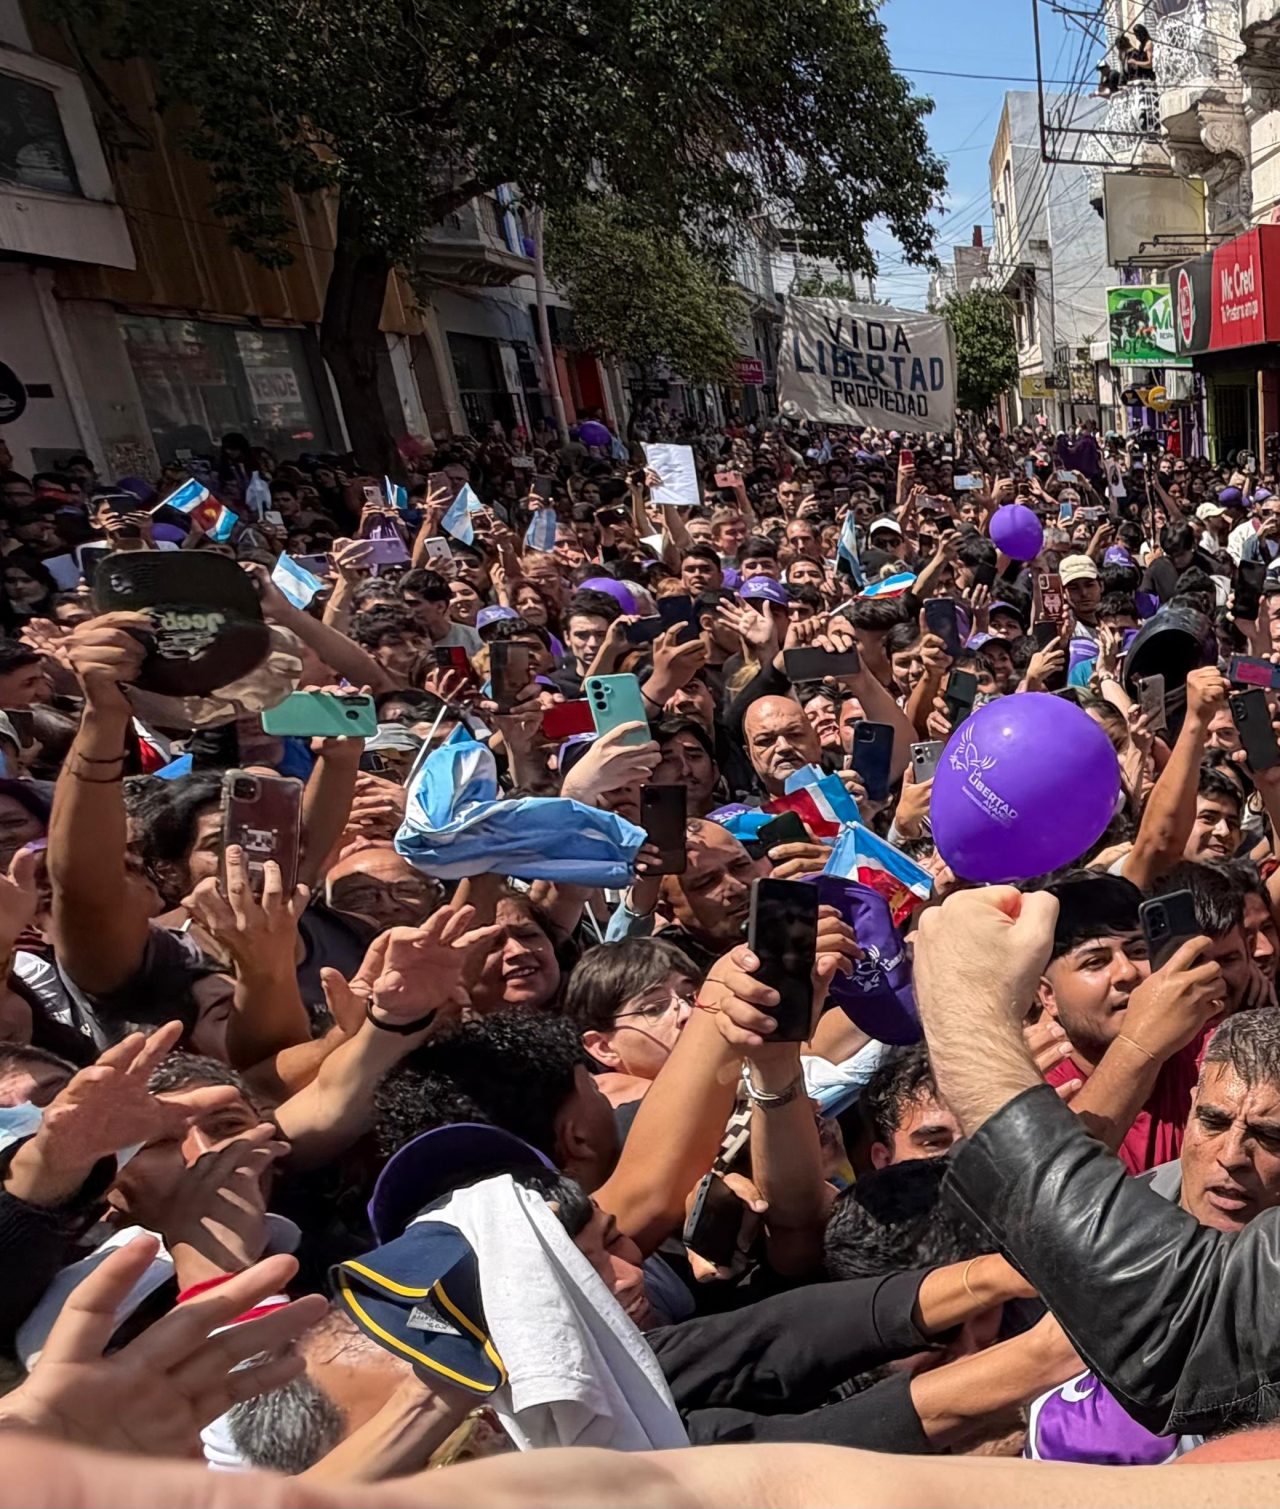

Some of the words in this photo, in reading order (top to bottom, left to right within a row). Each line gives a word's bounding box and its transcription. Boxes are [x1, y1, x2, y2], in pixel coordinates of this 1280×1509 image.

[793, 336, 944, 392] LIBERTAD
[831, 380, 928, 417] PROPIEDAD
[161, 611, 226, 633] Jeep
[973, 767, 982, 778] LA
[968, 773, 1018, 819] LIBERTAD
